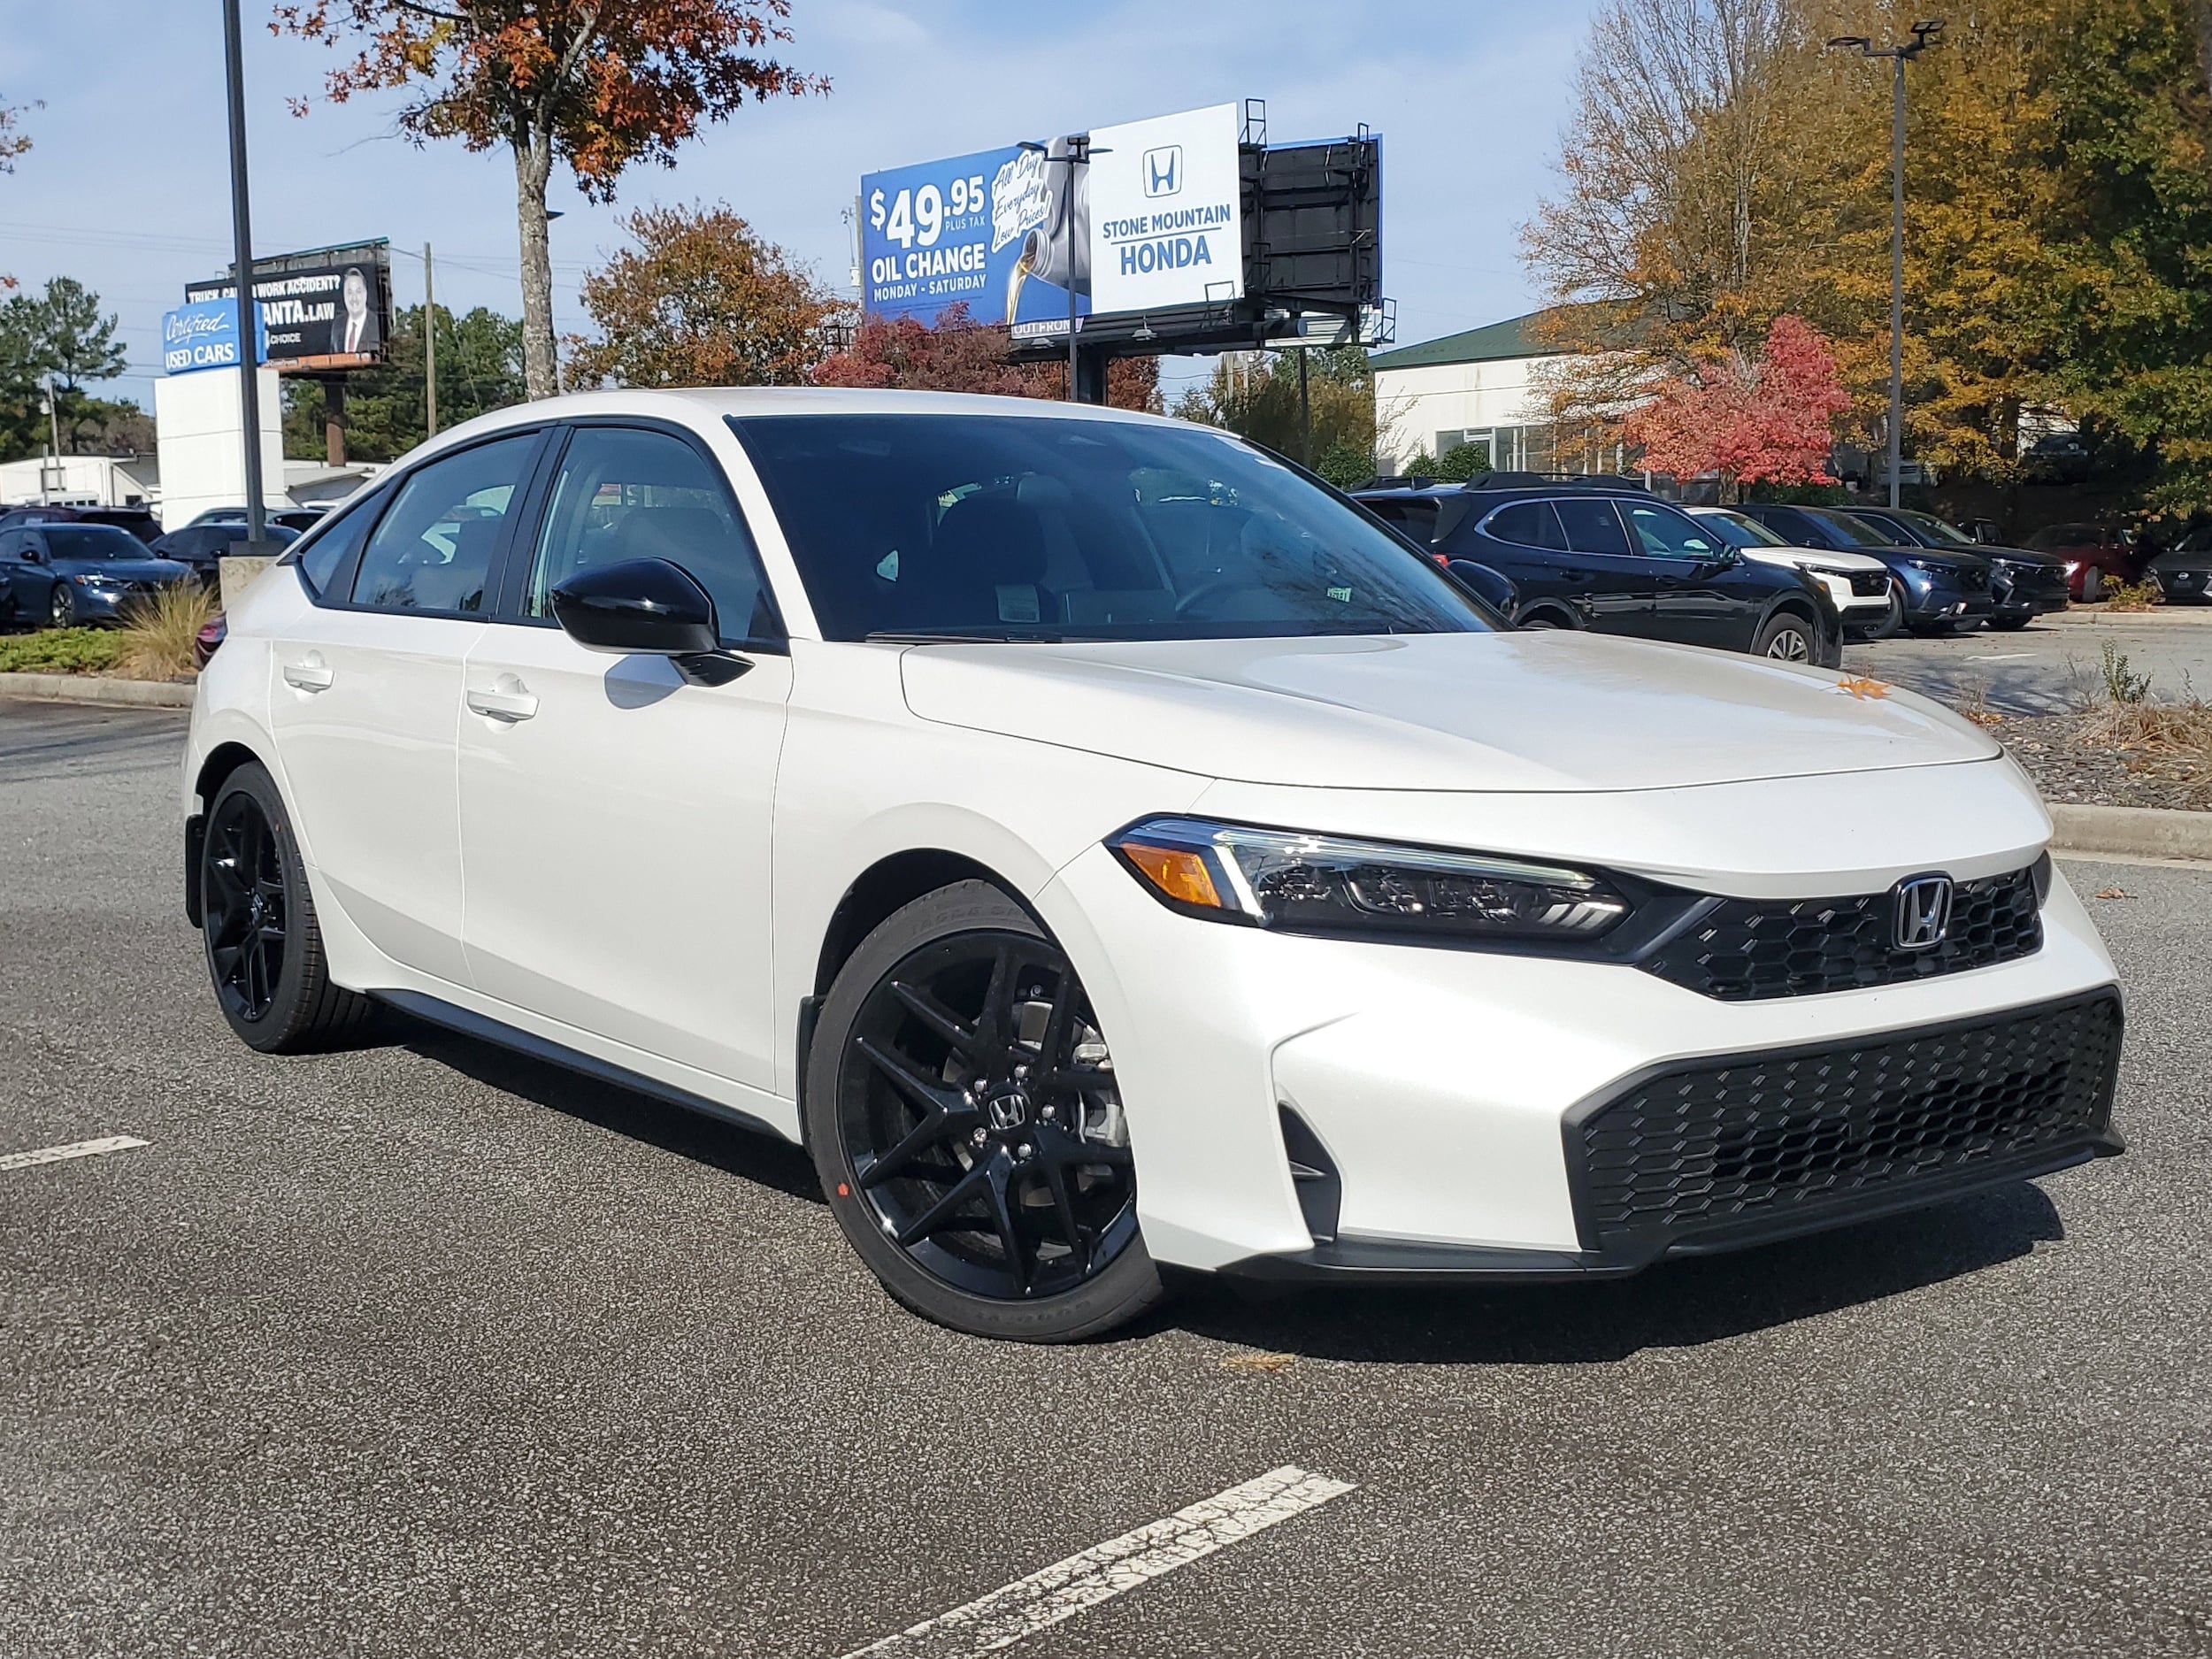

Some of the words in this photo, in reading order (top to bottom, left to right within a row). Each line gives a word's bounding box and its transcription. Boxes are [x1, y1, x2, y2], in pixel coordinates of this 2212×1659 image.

[995, 164, 1014, 196] All
[1017, 153, 1040, 180] Day
[871, 175, 985, 249] $49.95
[995, 180, 1040, 221] Everyday
[945, 218, 966, 232] PLUS
[969, 215, 985, 228] TAX
[994, 225, 1014, 249] Low
[1018, 194, 1050, 234] Prices!
[1102, 216, 1148, 239] STONE
[1151, 204, 1231, 232] MOUNTAIN
[872, 256, 902, 283] OIL
[905, 242, 986, 279] CHANGE
[1120, 234, 1212, 276] HONDA
[257, 280, 286, 298] WORK
[287, 273, 341, 296] ACCIDENT?
[873, 282, 918, 303] MONDAY
[929, 273, 987, 295] SATURDAY
[262, 299, 335, 326] ANTA.LAW
[1013, 319, 1071, 334] OUTFRON
[270, 332, 301, 345] CHOICE
[165, 349, 192, 370] USED
[194, 342, 234, 365] CARS
